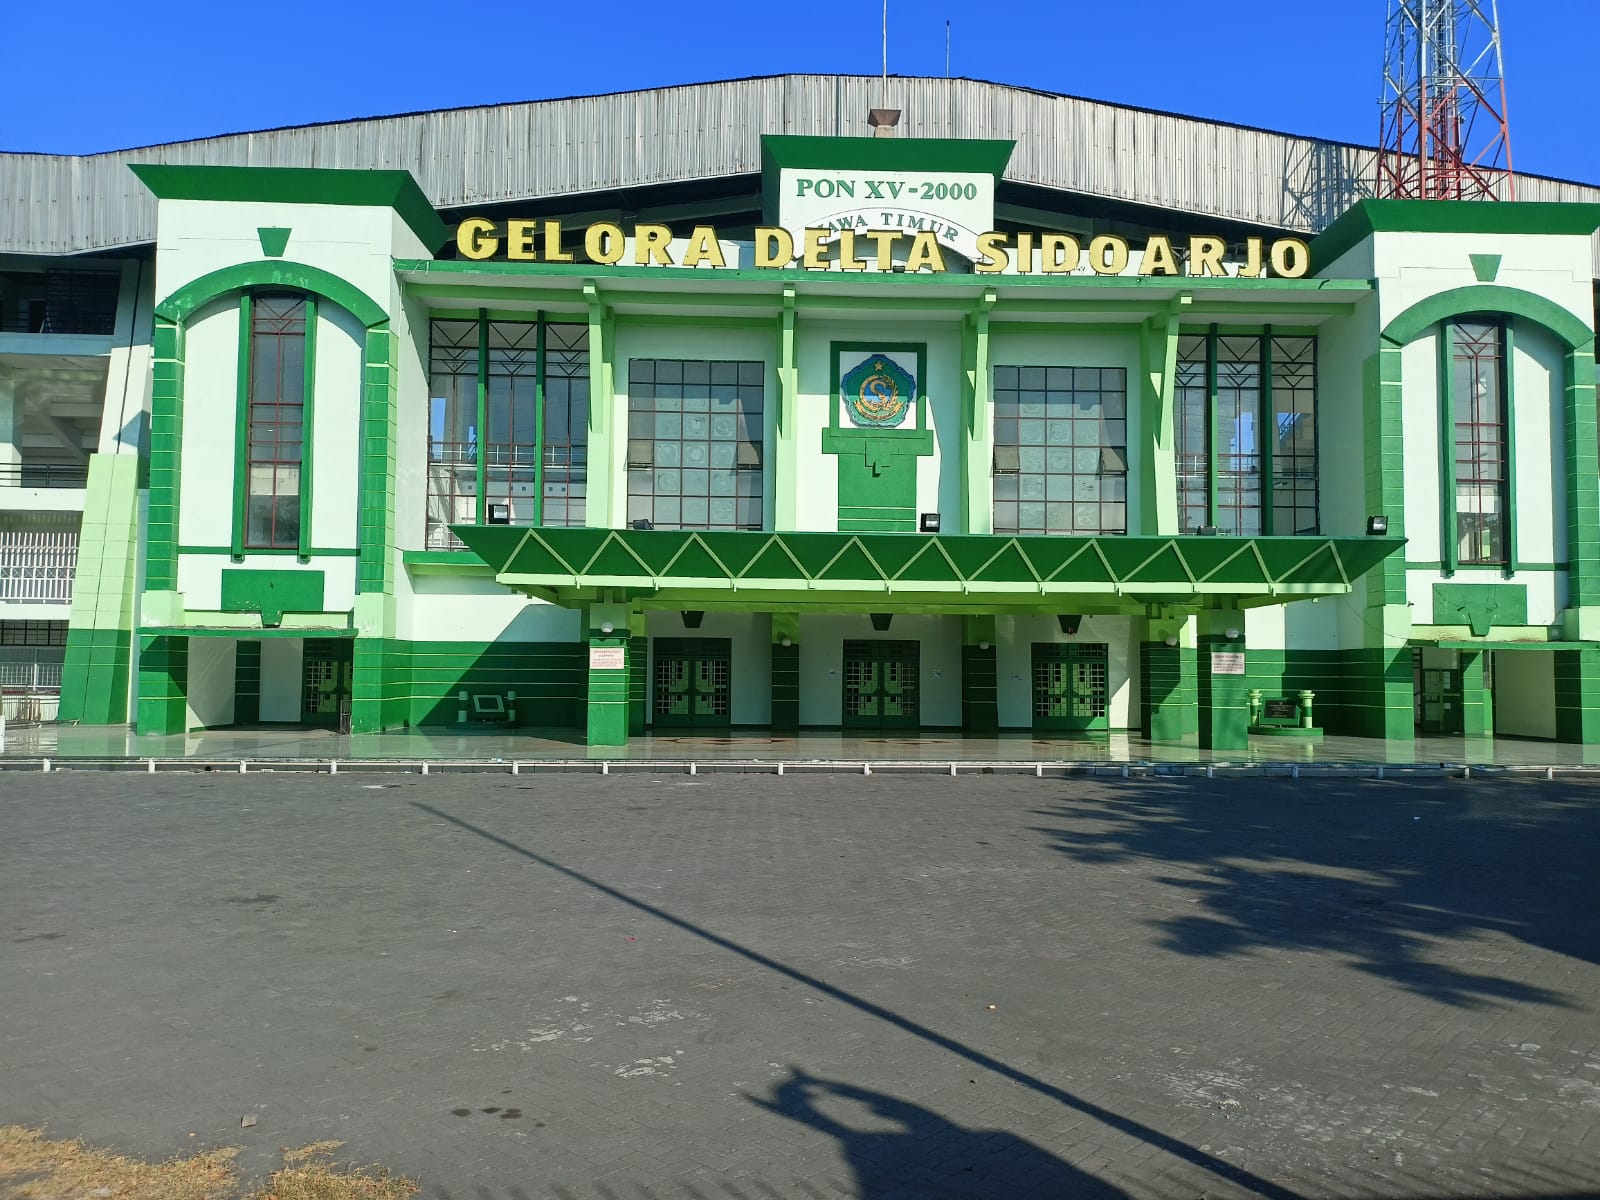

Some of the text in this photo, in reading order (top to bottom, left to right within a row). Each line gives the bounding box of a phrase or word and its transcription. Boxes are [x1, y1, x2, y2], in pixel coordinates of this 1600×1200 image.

[796, 178, 978, 201] PON XV-2000
[817, 212, 960, 242] AWA TIMUR
[456, 216, 1311, 279] GELORA DELTA SIDOARJO
